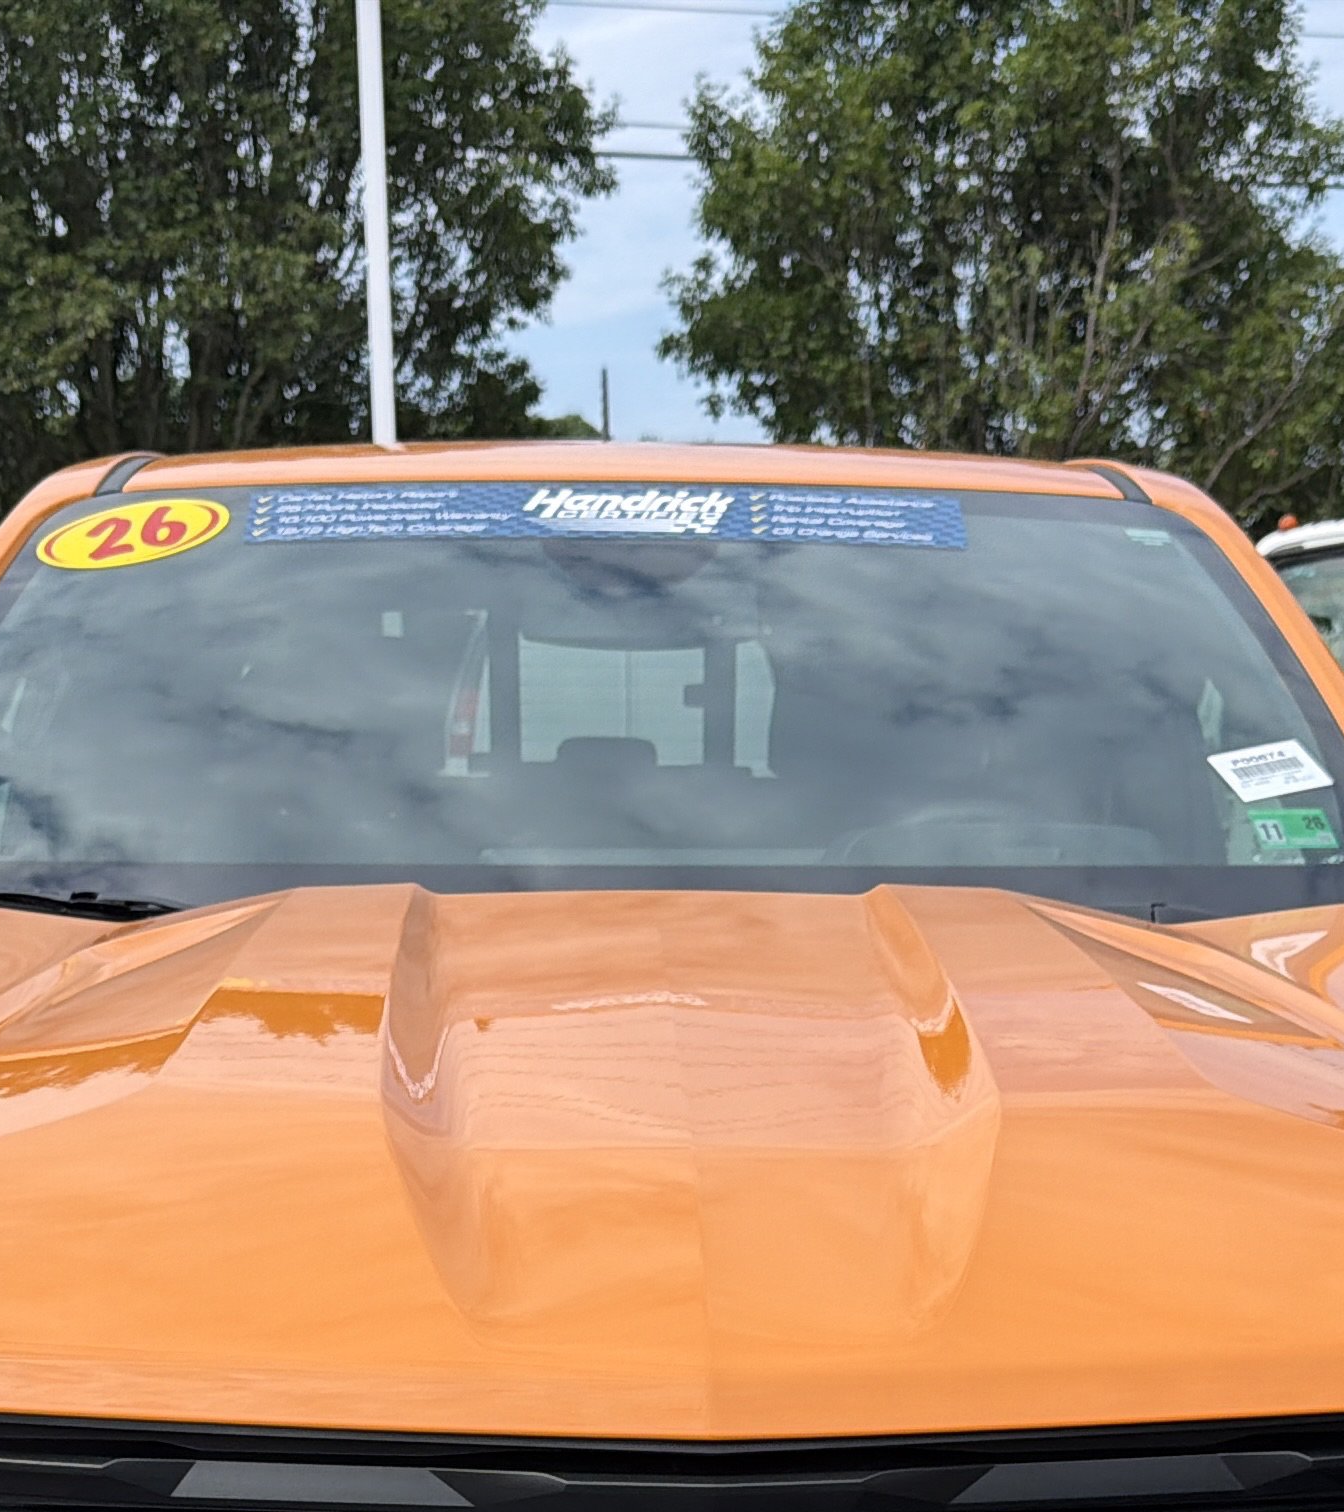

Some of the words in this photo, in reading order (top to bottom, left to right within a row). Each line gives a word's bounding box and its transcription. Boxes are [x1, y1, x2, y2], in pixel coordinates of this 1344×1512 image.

[522, 488, 735, 518] Hendrick
[86, 506, 188, 561] 26
[1259, 823, 1284, 840] 11
